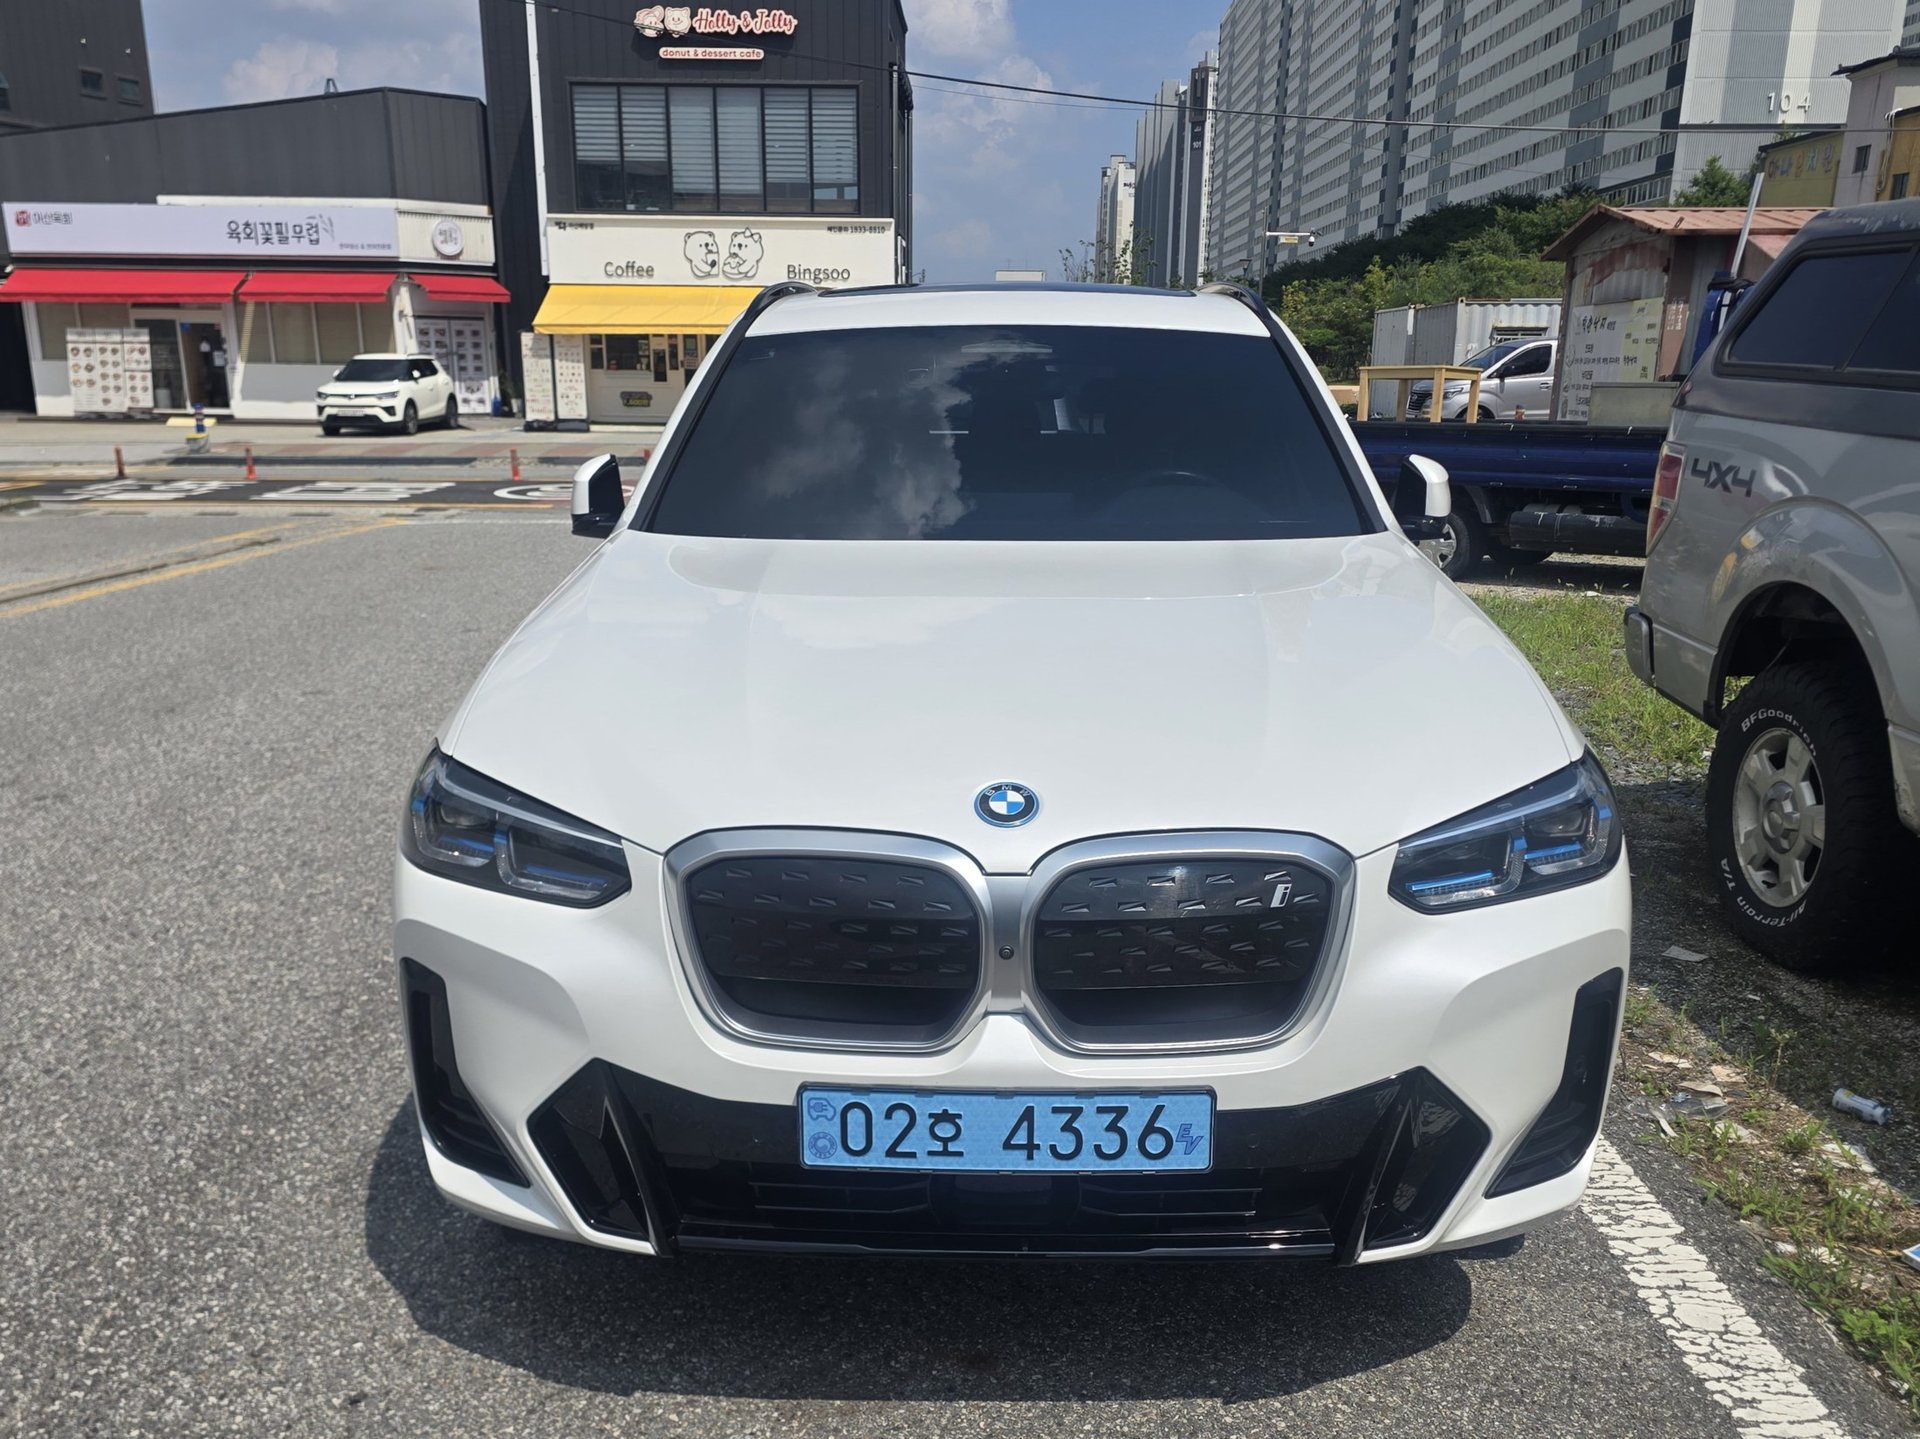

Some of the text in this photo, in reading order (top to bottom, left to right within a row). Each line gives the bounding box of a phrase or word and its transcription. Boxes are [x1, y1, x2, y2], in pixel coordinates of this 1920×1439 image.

[694, 10, 795, 34] Holly & Jolly
[662, 48, 762, 58] donut & dessert cafe
[604, 261, 655, 278] Coffee
[787, 264, 851, 285] Bingsoo
[984, 784, 1031, 797] BMW
[1736, 896, 1808, 928] All-Terrain
[839, 1101, 965, 1159] 02호
[1001, 1104, 1175, 1162] 4336
[1175, 1123, 1205, 1156] EV
